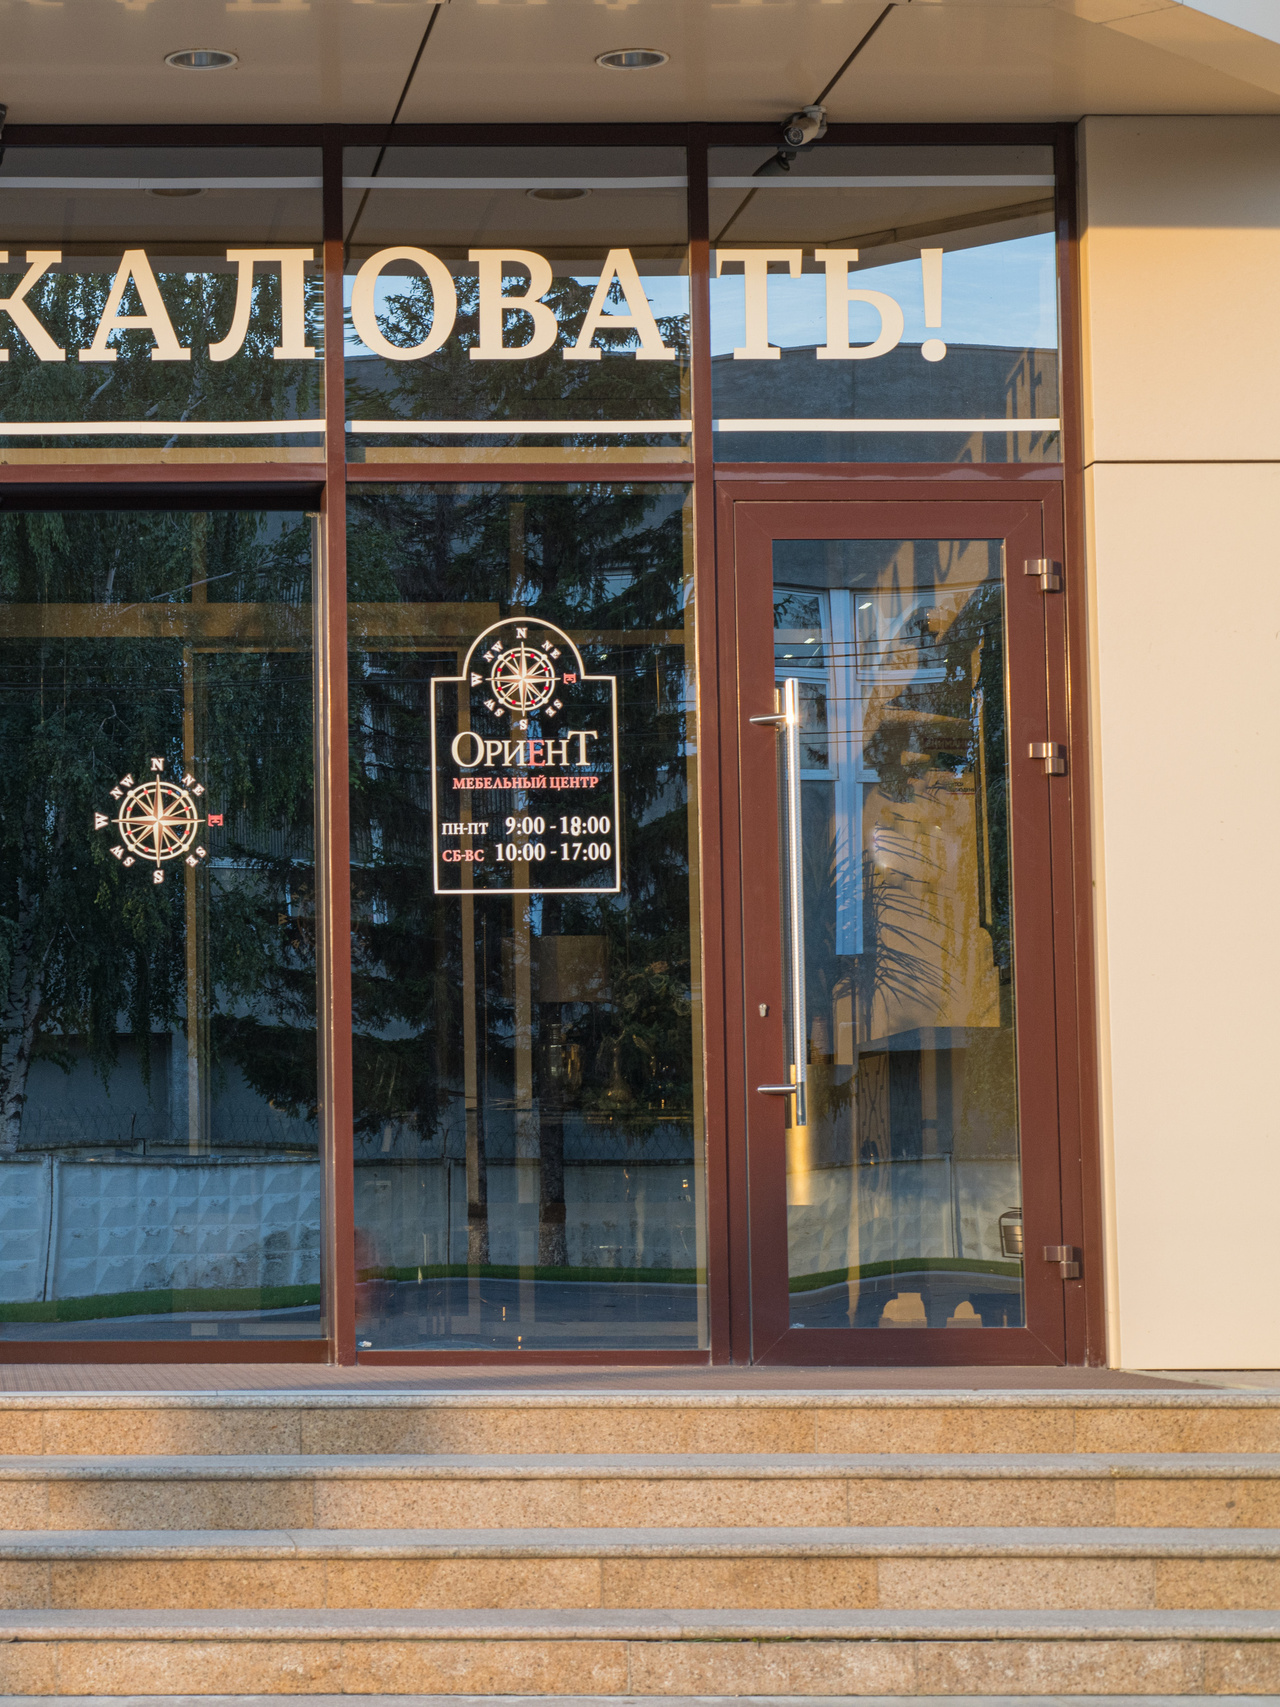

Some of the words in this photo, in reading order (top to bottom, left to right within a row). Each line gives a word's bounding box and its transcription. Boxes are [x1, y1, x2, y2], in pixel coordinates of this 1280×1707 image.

[516, 627, 528, 639] N
[471, 672, 483, 688] W
[563, 673, 577, 685] E
[519, 719, 528, 731] S
[451, 730, 599, 768] ОРИЕНТ
[150, 757, 165, 771] N
[452, 775, 547, 790] МЕБЕЛЬНЫЙ
[549, 776, 599, 791] ЦЕНТР
[94, 812, 109, 830] W
[207, 813, 224, 827] E
[441, 822, 489, 835] ПН-ПТ
[505, 816, 546, 835] 9:00
[560, 816, 611, 836] 18:00
[442, 850, 485, 862] СБ-ВС
[495, 842, 546, 861] 10:00
[560, 842, 611, 861] 17:00
[153, 869, 164, 884] S
